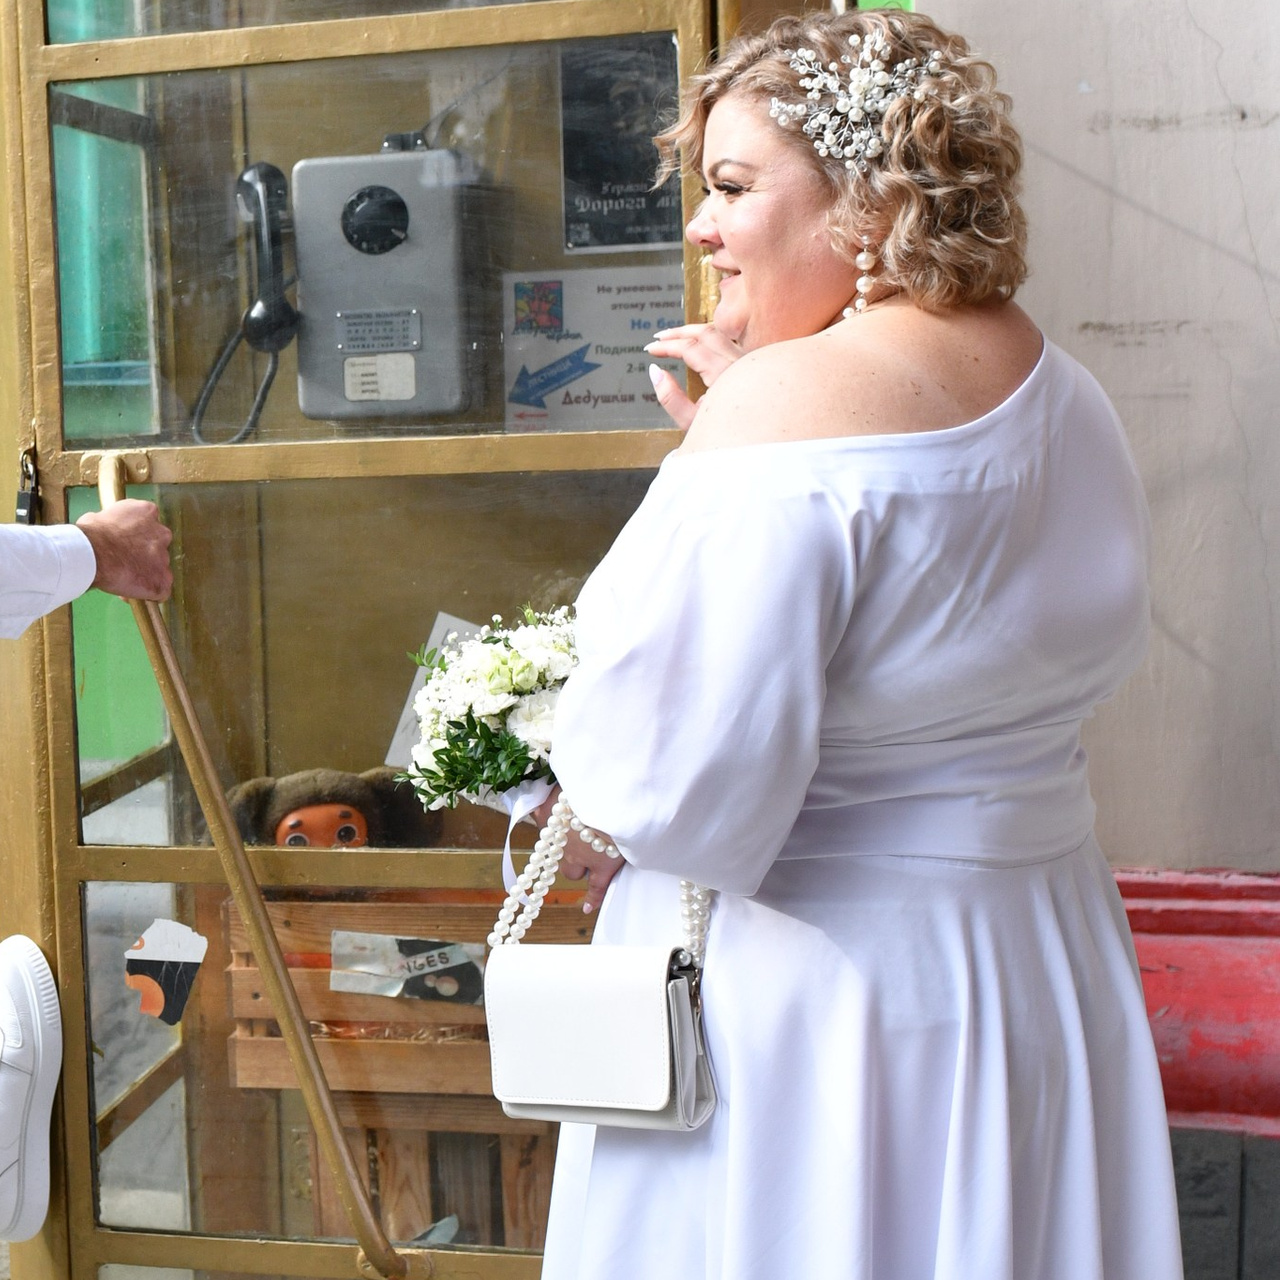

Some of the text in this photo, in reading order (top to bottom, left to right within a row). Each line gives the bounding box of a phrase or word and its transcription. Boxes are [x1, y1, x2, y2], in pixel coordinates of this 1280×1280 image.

[597, 285, 612, 294] Не
[617, 283, 663, 295] умеешь
[611, 301, 645, 311] этому
[630, 319, 651, 331] Не
